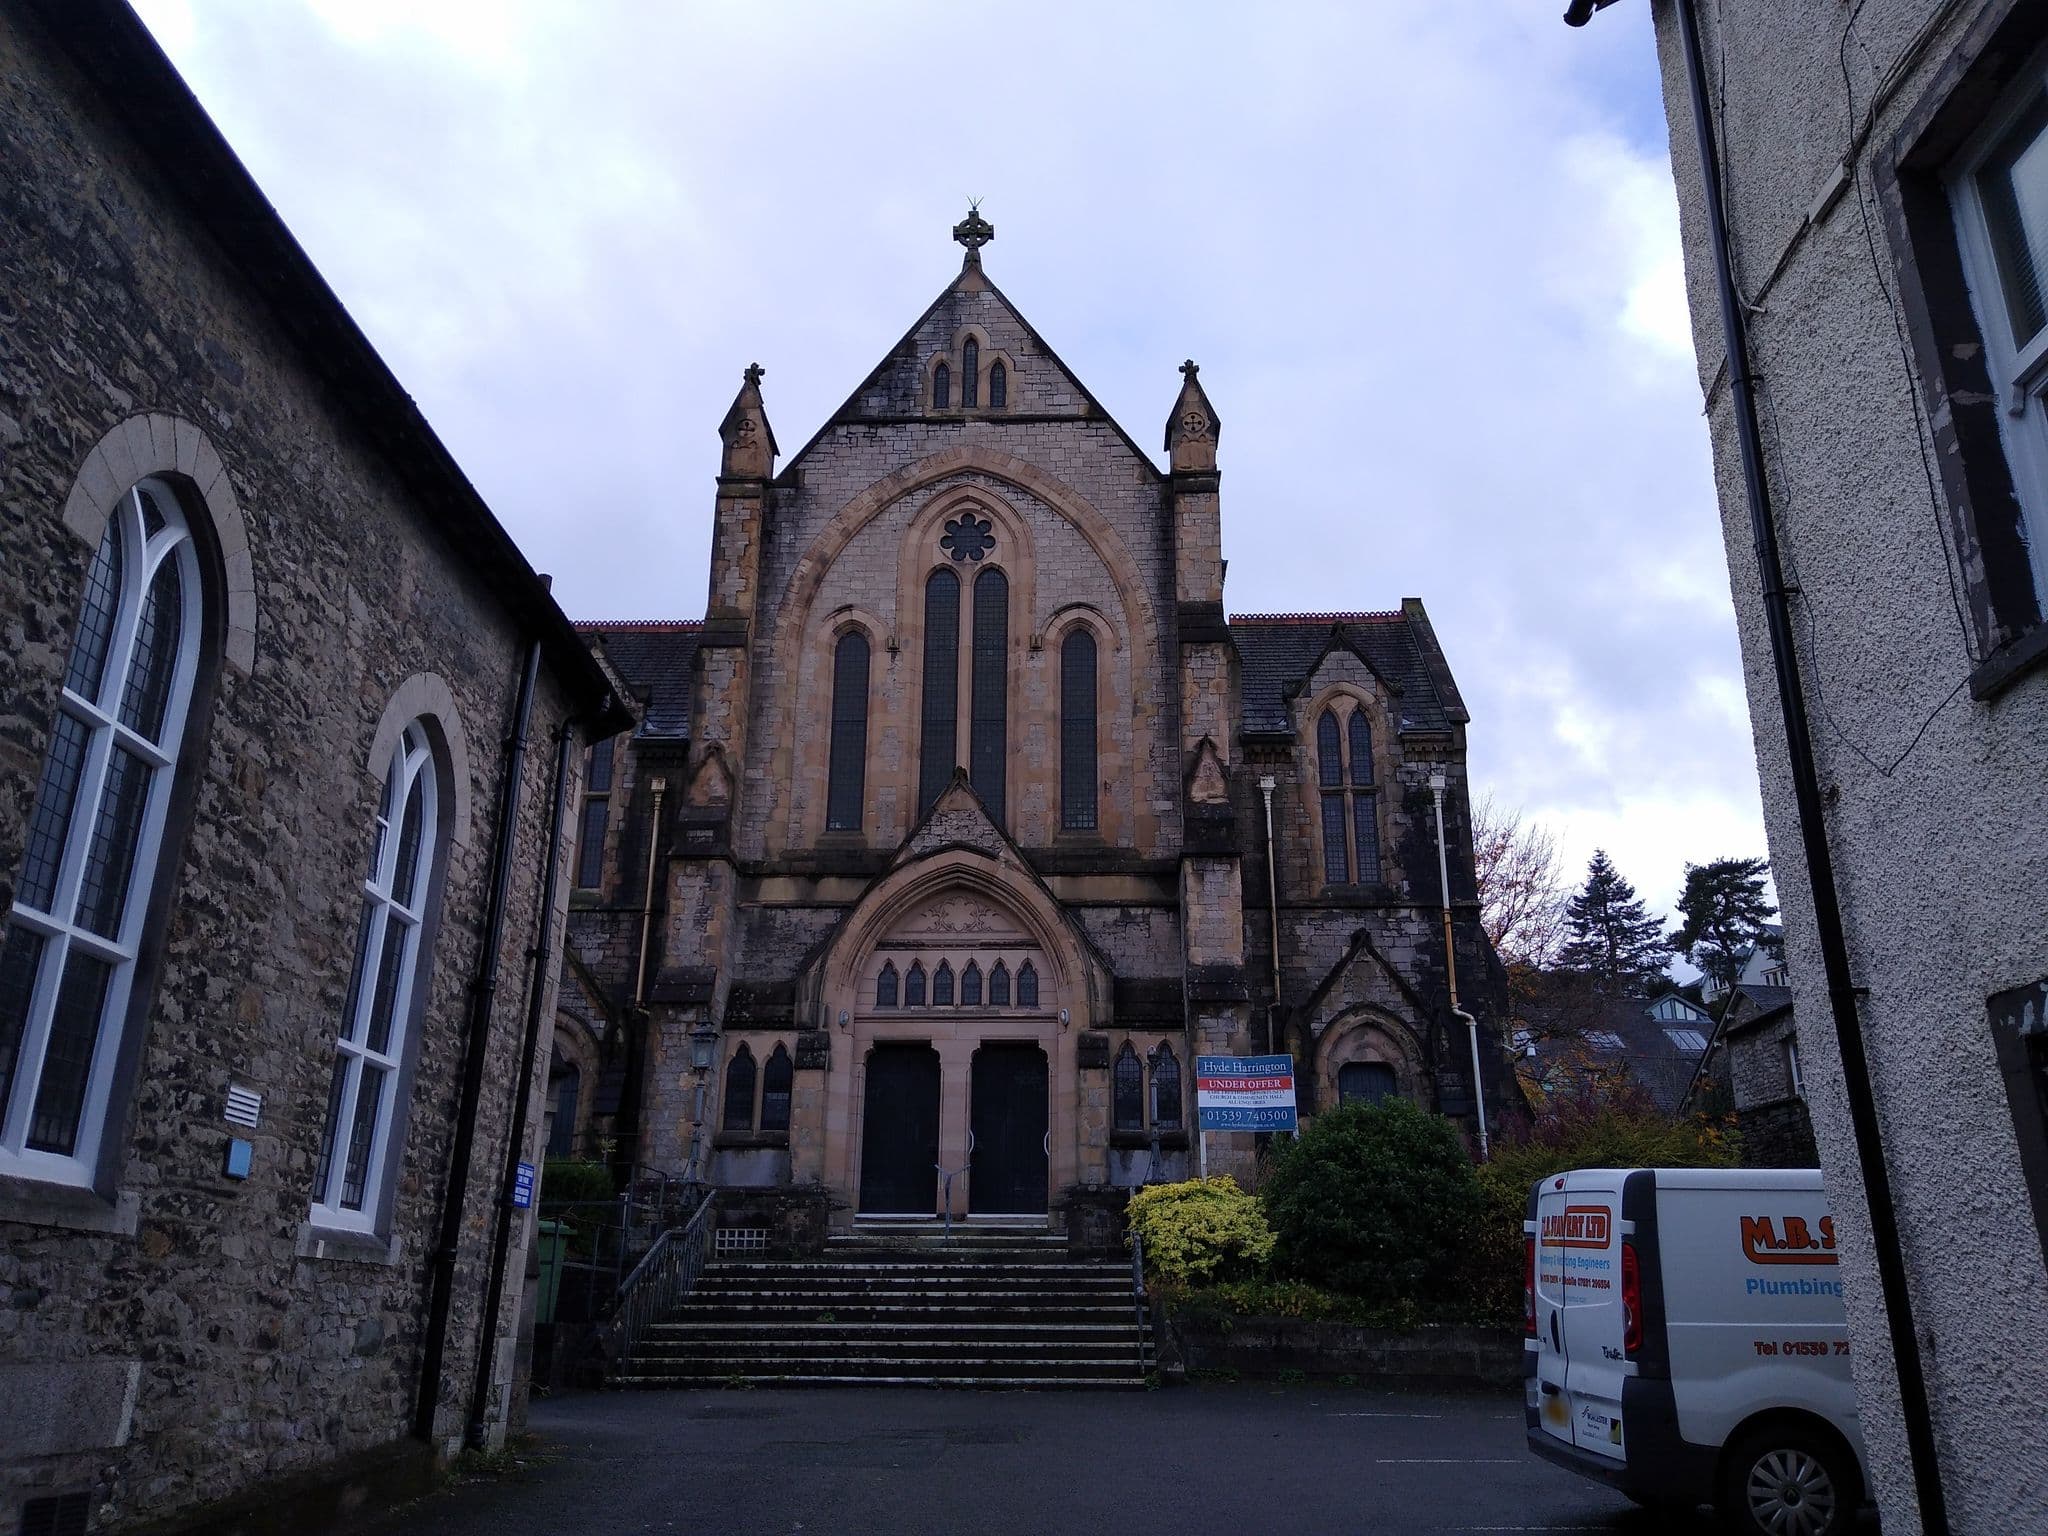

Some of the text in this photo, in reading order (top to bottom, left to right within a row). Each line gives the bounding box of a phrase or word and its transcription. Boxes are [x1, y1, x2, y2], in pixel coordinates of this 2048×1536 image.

[1204, 1061, 1286, 1074] Hyde Harrington
[1208, 1079, 1281, 1089] UNDER OFFER
[1207, 1110, 1288, 1121] 01539 740500
[1585, 1215, 1606, 1239] LTD
[1578, 1256, 1610, 1270] Engineers
[1746, 1278, 1843, 1297] Plumbing
[1754, 1341, 1778, 1355] Tel
